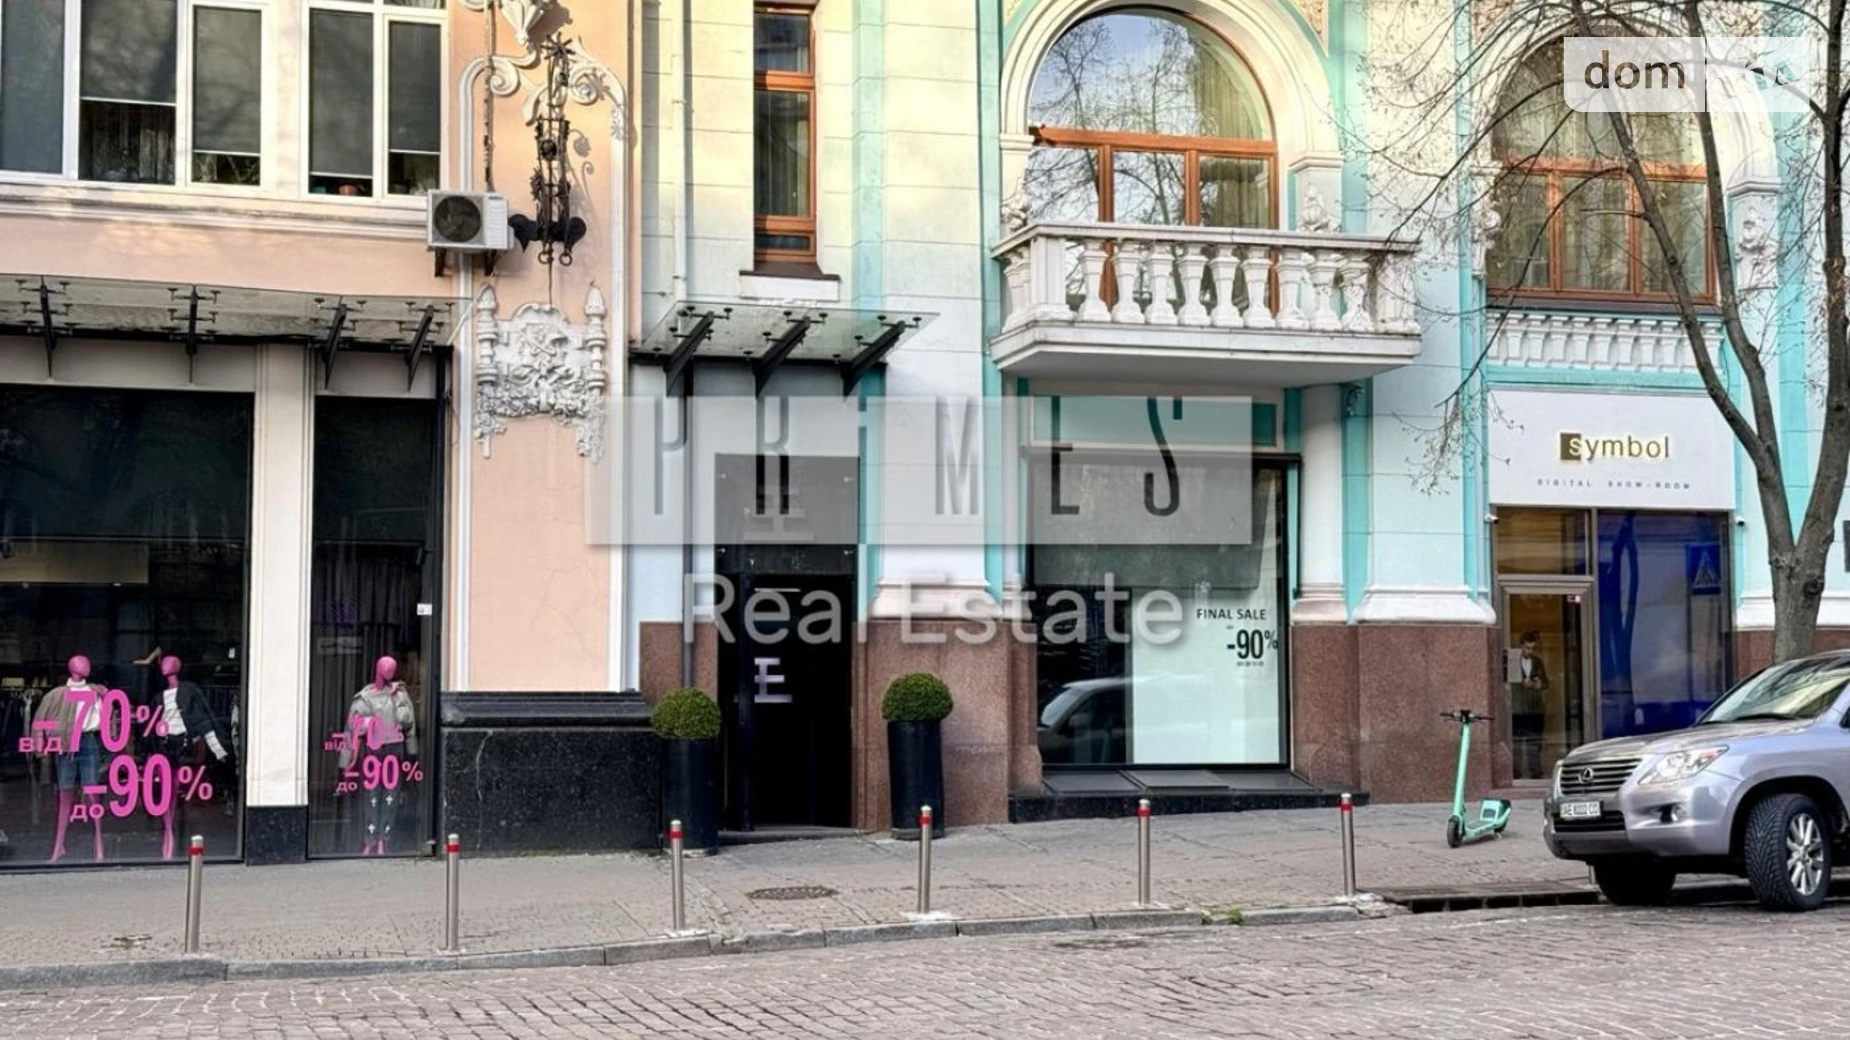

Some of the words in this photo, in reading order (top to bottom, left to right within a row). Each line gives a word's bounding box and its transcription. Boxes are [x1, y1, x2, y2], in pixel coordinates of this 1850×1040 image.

[1561, 433, 1670, 461] symbol
[1196, 608, 1233, 621] FINAL
[1236, 608, 1267, 621] SALE
[1226, 628, 1279, 660] -90%
[18, 736, 63, 756] від
[335, 782, 359, 794] до
[69, 803, 106, 823] до
